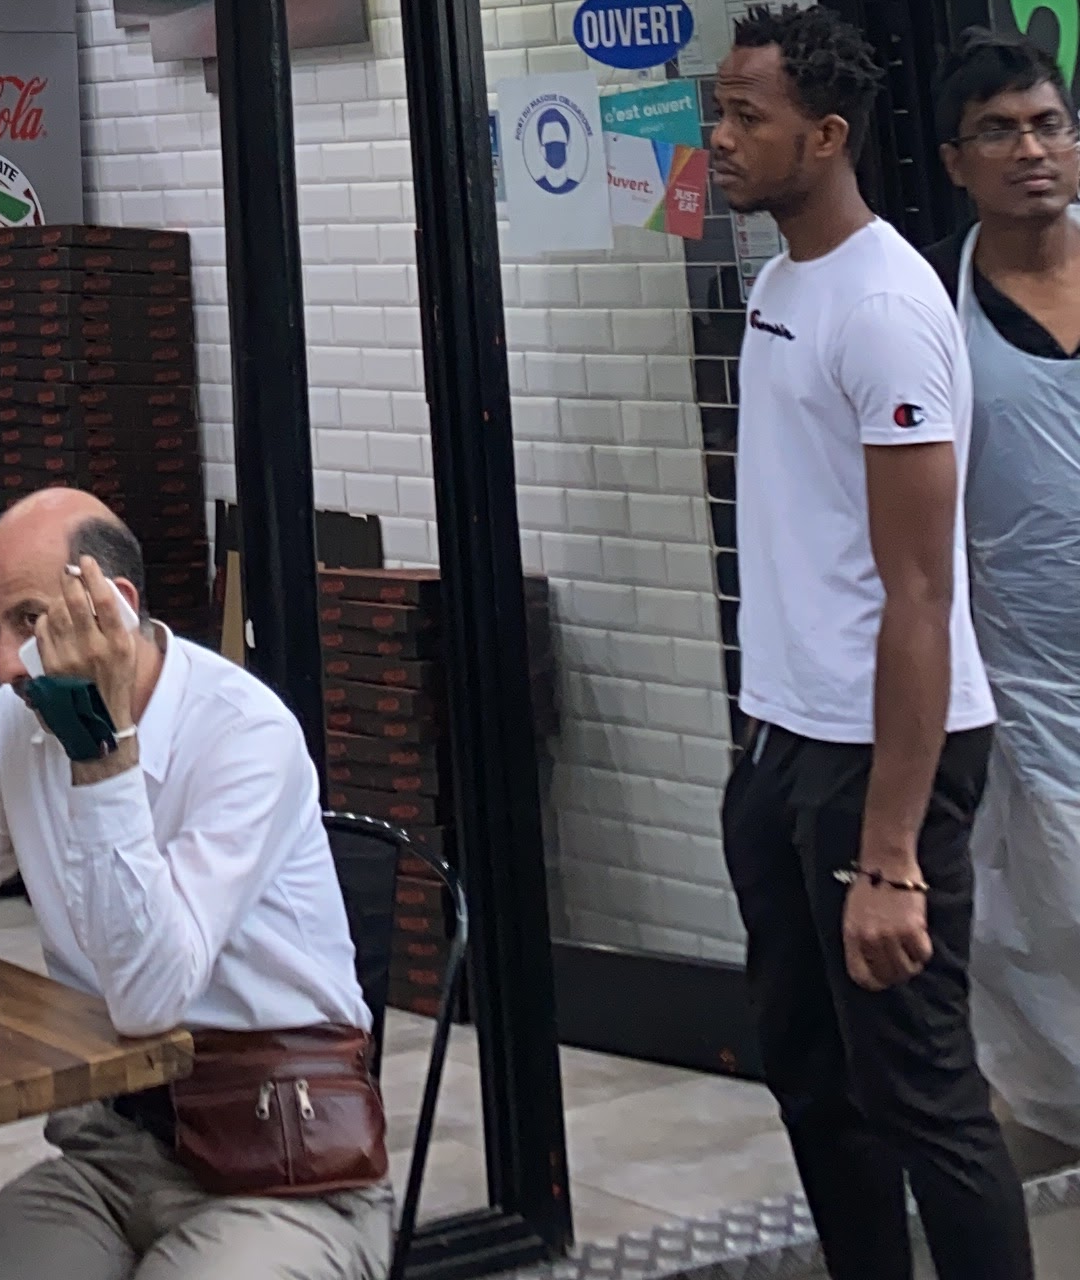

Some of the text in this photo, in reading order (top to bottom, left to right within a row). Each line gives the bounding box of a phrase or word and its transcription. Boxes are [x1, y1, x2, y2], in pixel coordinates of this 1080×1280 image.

[581, 4, 683, 50] OUVERT
[604, 95, 694, 124] c'est ouvert
[673, 188, 701, 204] JUST
[678, 200, 700, 214] EAT
